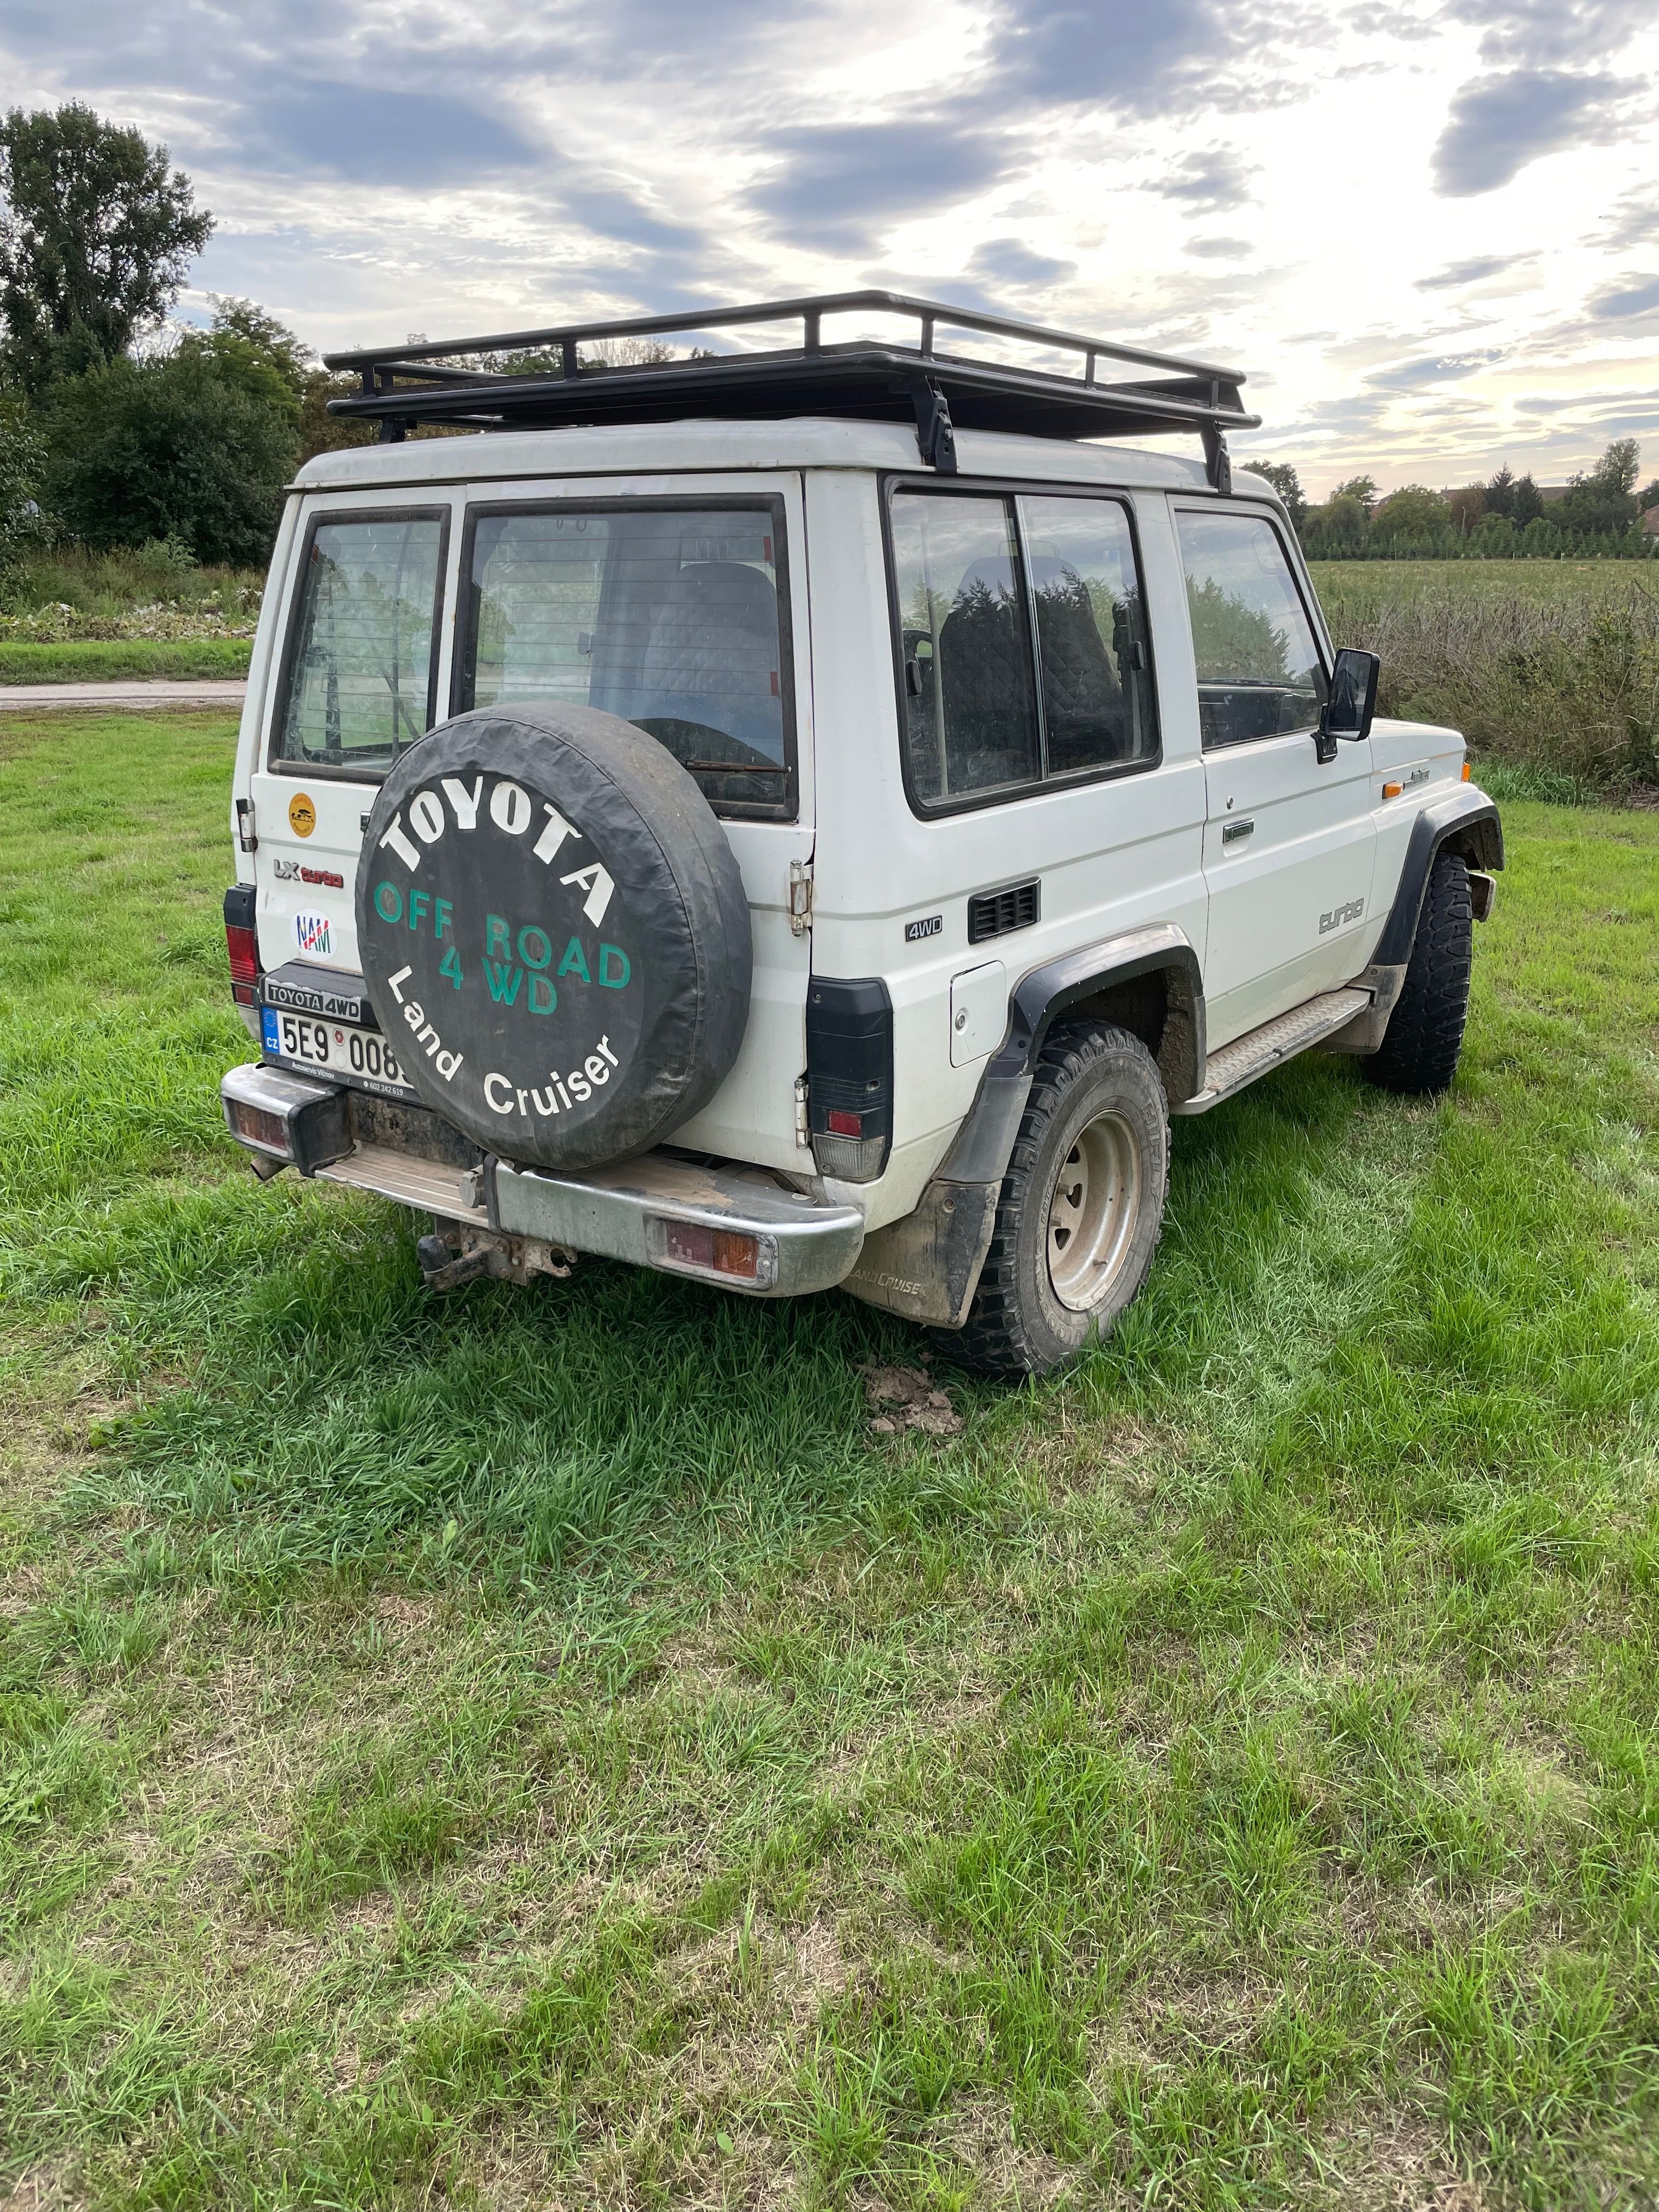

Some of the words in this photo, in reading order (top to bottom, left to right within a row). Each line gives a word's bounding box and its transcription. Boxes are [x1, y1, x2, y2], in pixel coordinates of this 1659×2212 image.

[274, 859, 300, 881] LX
[379, 776, 615, 928] TOYOTA
[297, 915, 330, 953] NAM
[909, 917, 942, 939] 4WD
[1319, 898, 1364, 934] turbo
[374, 882, 453, 938] OFF
[486, 914, 631, 990] ROAD
[439, 947, 464, 990] 4
[482, 958, 558, 1015] WD
[270, 986, 320, 1011] TOYOTA
[325, 998, 359, 1018] 4WD
[266, 1037, 279, 1049] CZ
[283, 1017, 329, 1063] 5E9
[349, 1033, 411, 1083] 008
[388, 965, 464, 1082] Land
[484, 1035, 620, 1117] Cruiser
[292, 1062, 317, 1075] Autoservis
[369, 1082, 380, 1091] 602
[381, 1084, 391, 1093] 242
[392, 1087, 404, 1096] 619
[1141, 1102, 1161, 1213] HIFLY
